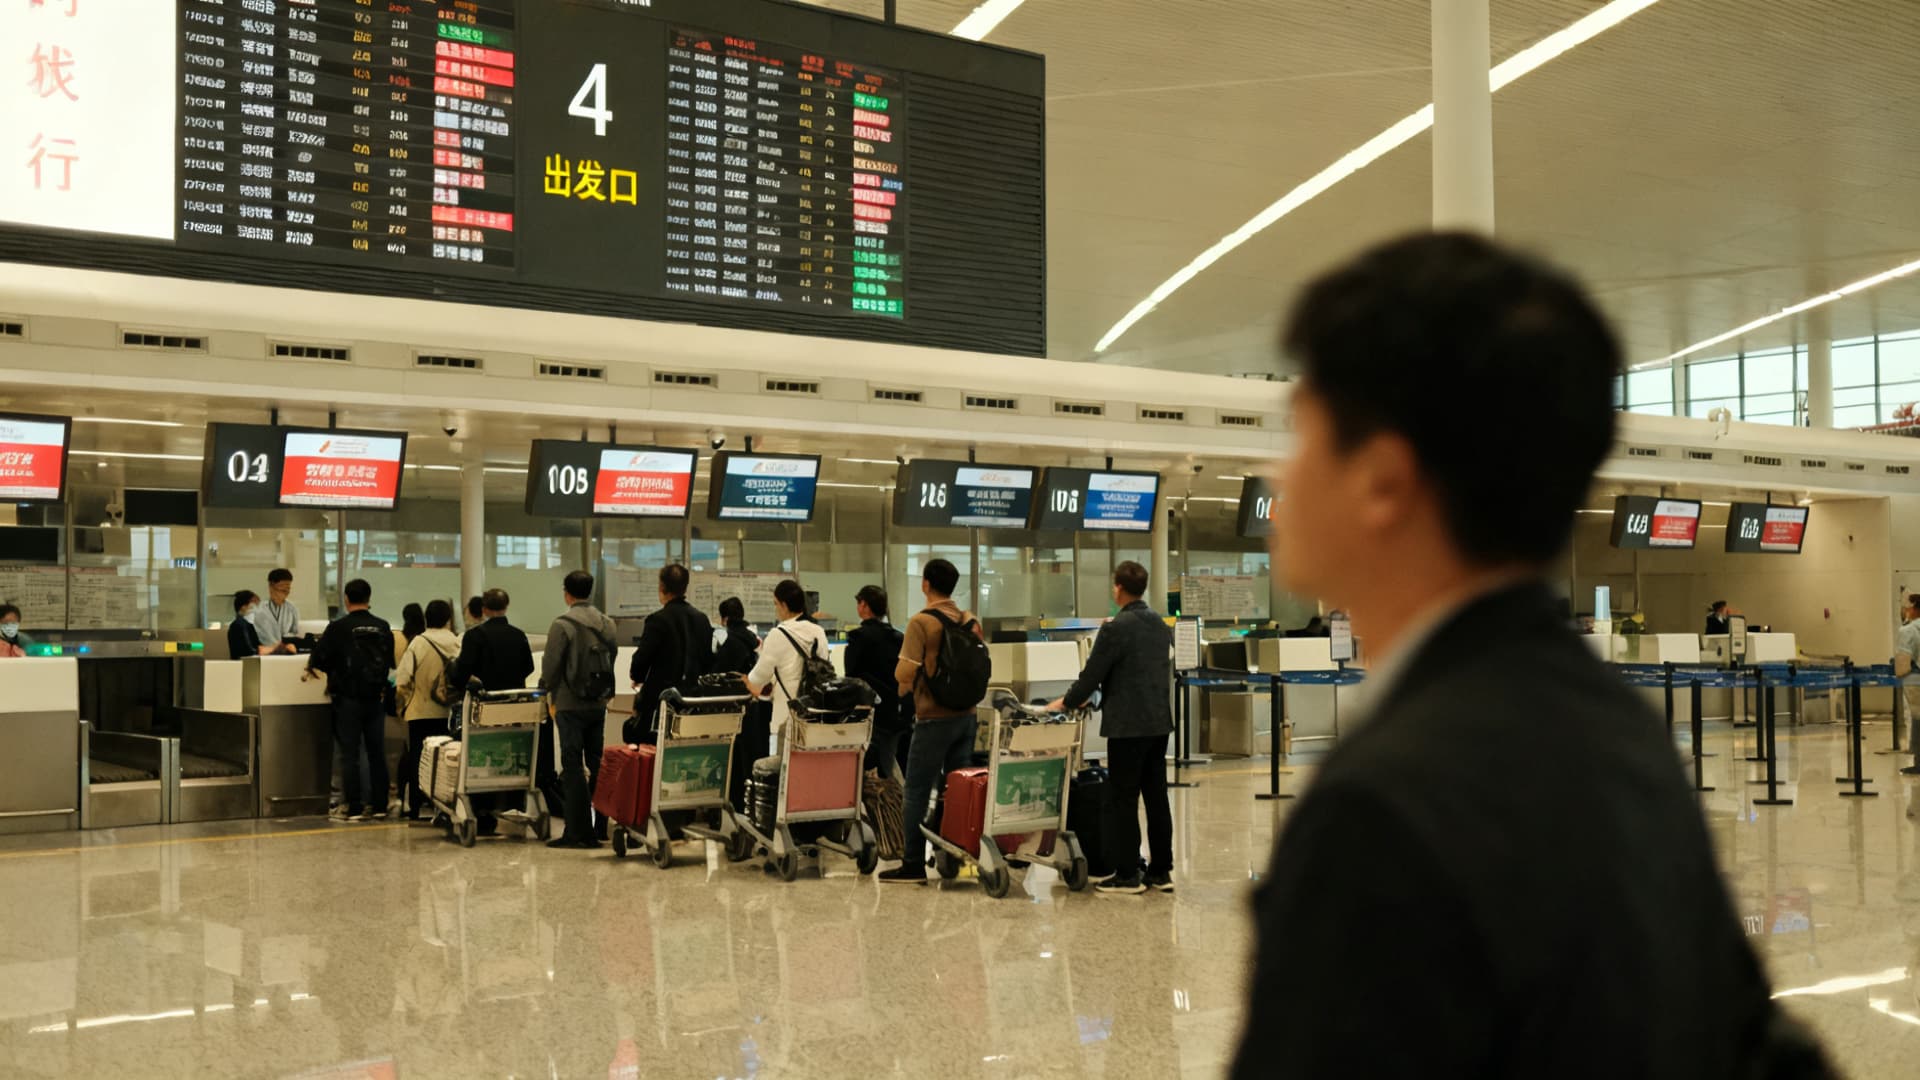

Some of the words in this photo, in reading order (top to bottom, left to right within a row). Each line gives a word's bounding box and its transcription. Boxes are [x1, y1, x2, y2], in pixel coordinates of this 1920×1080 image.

[568, 63, 613, 136] 4
[544, 153, 637, 206] 出发口
